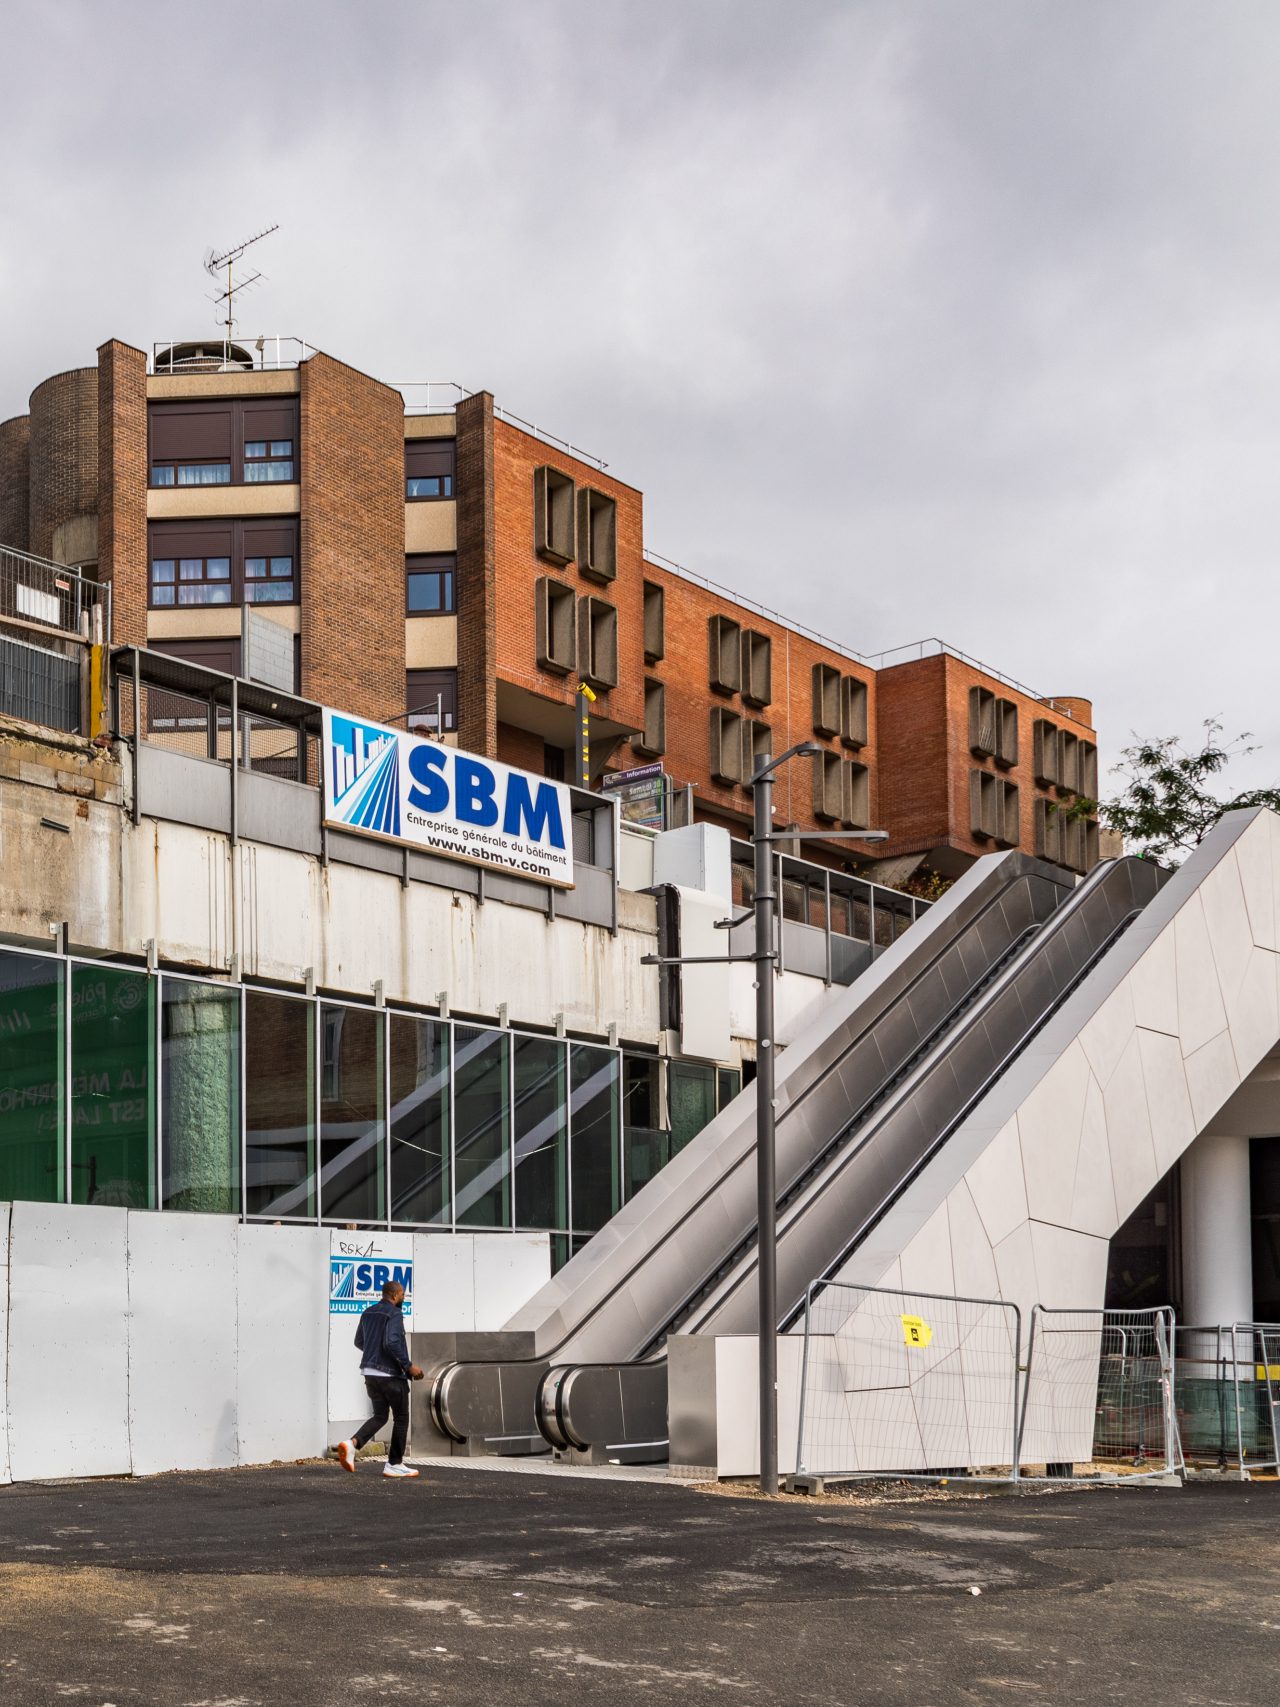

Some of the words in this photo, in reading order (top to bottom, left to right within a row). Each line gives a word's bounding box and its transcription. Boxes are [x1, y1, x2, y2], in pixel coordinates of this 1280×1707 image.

[626, 765, 661, 779] Information
[408, 745, 566, 850] SBM
[406, 813, 459, 836] Entreprise
[462, 829, 508, 849] générale
[511, 841, 523, 853] du
[526, 845, 567, 865] bâtiment
[427, 836, 551, 877] www.sbm-v.com
